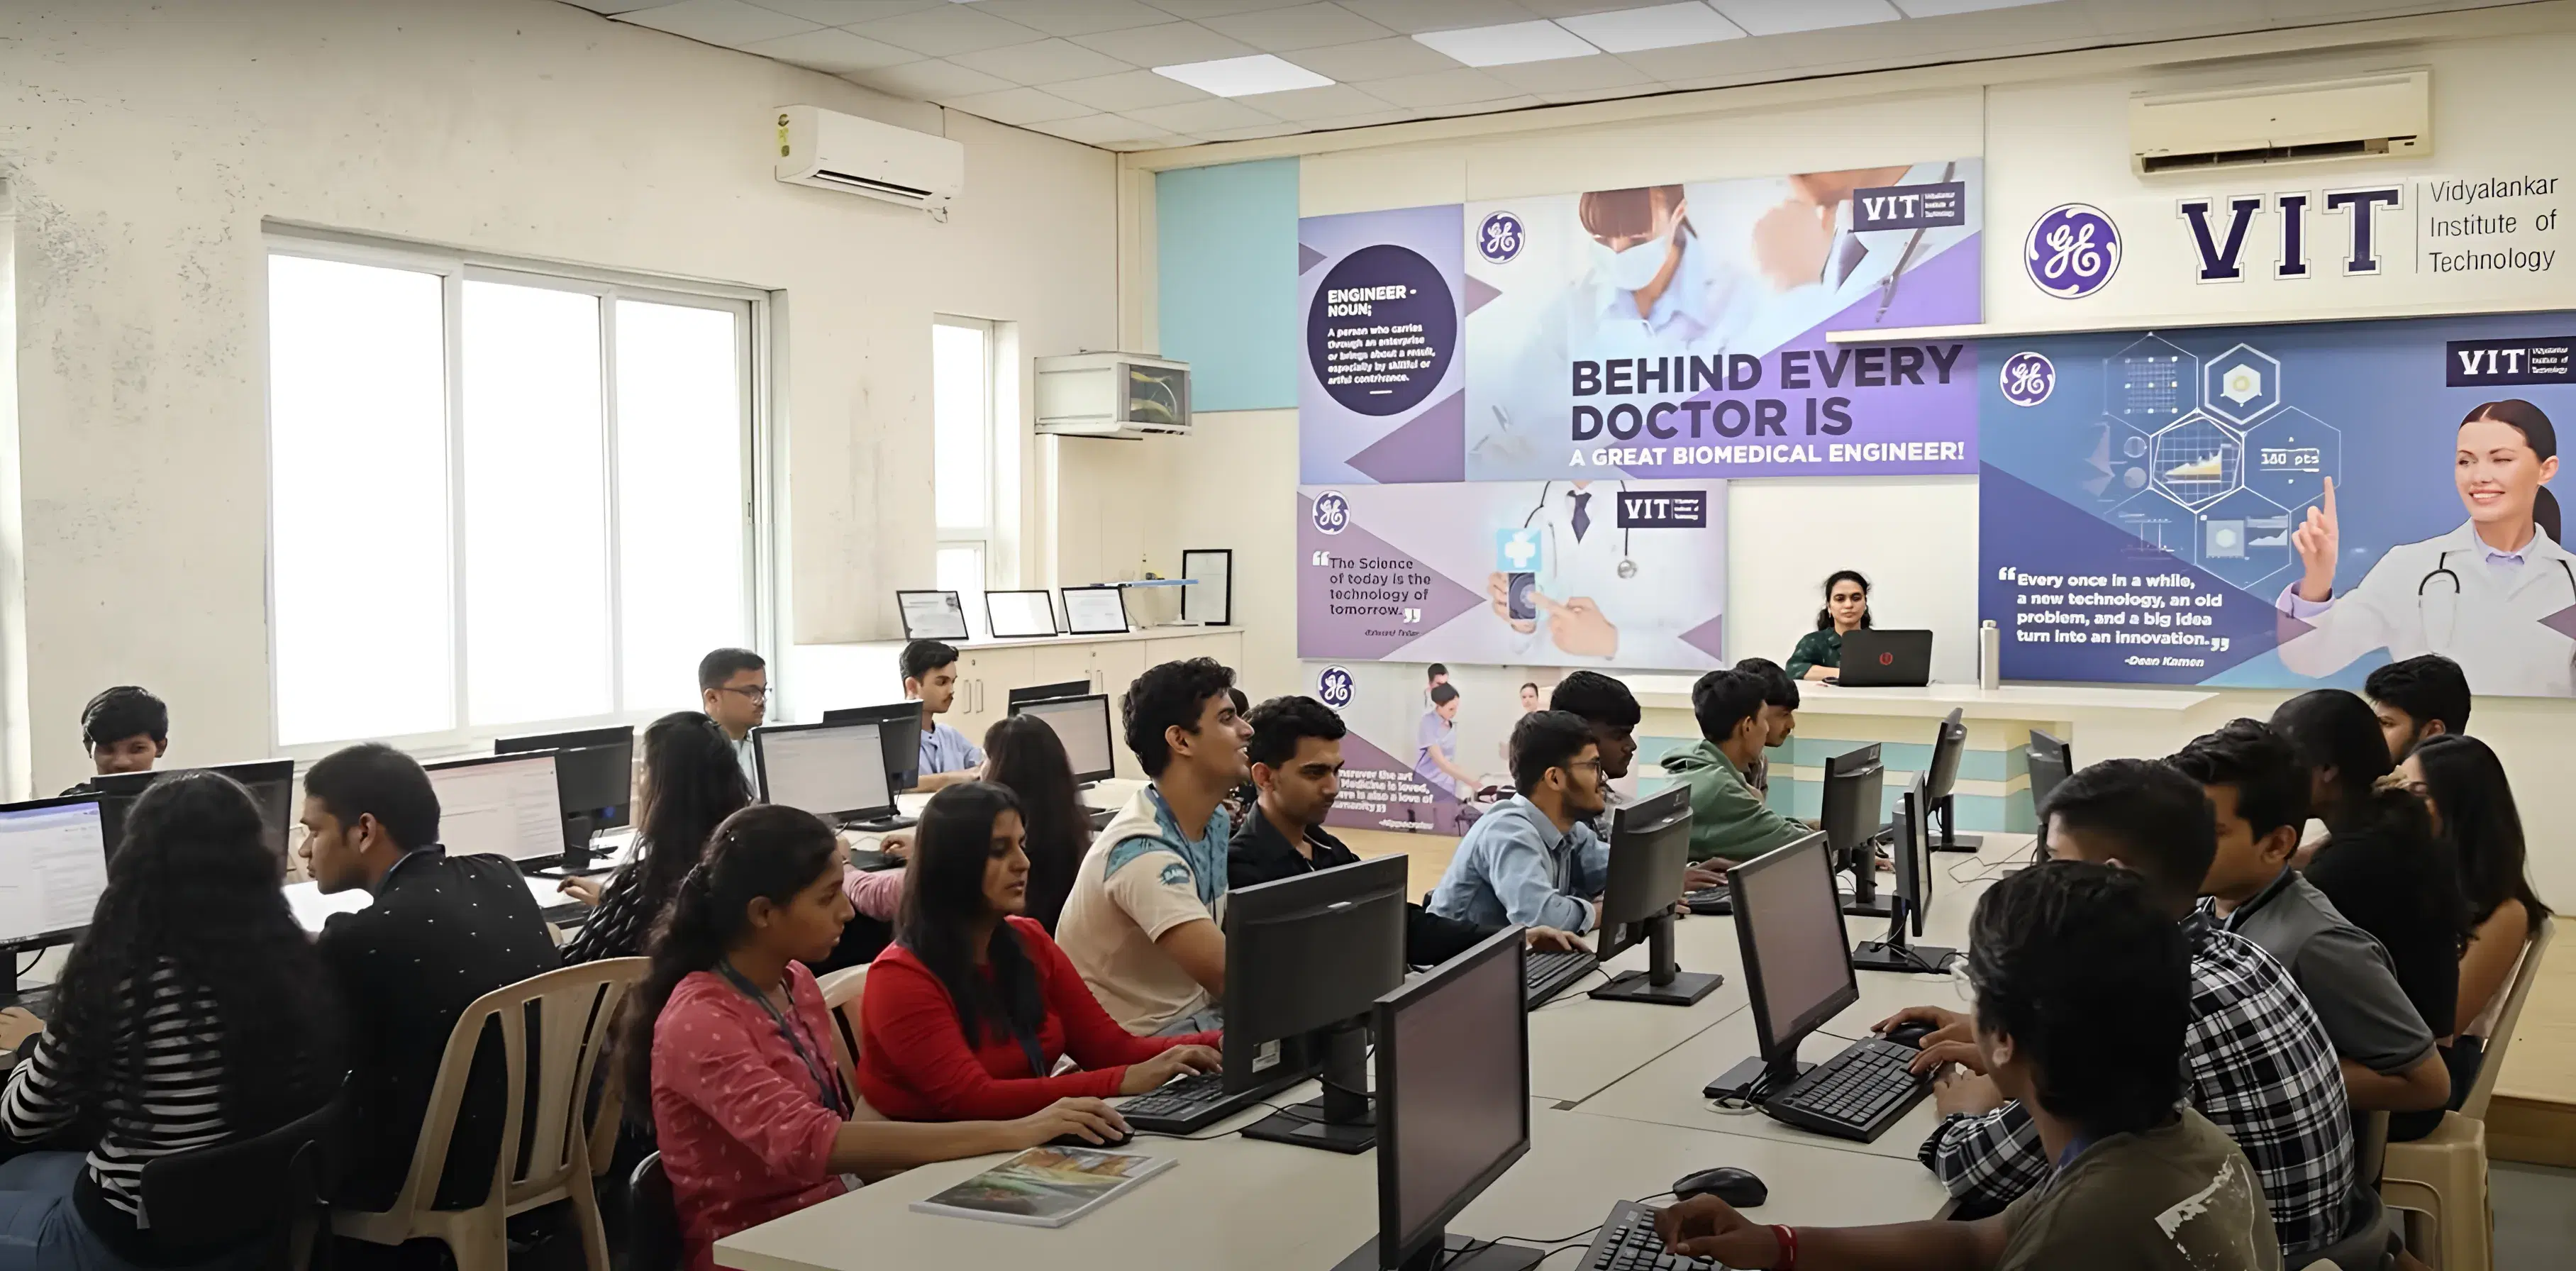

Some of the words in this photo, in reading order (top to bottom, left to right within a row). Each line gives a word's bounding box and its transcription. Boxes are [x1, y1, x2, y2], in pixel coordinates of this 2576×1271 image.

[2431, 175, 2558, 204] Vidyalankar
[1862, 194, 1919, 221] VIT
[2431, 214, 2516, 237] Institute
[2536, 209, 2557, 231] of
[2177, 185, 2403, 284] VIT
[2428, 248, 2555, 272] Technology
[1328, 284, 1406, 304] ENGINEER
[1328, 303, 1372, 317] NOUN;
[1328, 328, 1336, 338] A
[1370, 325, 1389, 335] who
[1572, 353, 1762, 396] BEHIND
[1781, 344, 1963, 389] EVERY
[2458, 349, 2526, 374] VIT
[1572, 396, 1787, 441] DOCTOR
[1806, 396, 1853, 436] IS
[1568, 450, 1586, 467] A
[1592, 447, 1667, 465] GREAT
[1673, 443, 1822, 465] BIOMEDICAL
[1829, 441, 1965, 462] ENGINEER!
[1624, 499, 1670, 519] VIT
[1359, 557, 1414, 570] Science
[1330, 573, 1344, 584] of
[1348, 573, 1388, 586] today
[1393, 573, 1404, 584] is
[1408, 573, 1431, 585] the
[2067, 575, 2107, 587] once
[2111, 573, 2127, 587] in
[2131, 575, 2141, 587] a
[2145, 574, 2195, 589] while,
[1330, 589, 1409, 602] technology
[1414, 589, 1428, 600] of
[2017, 594, 2027, 604] a
[2031, 594, 2063, 605] new
[2068, 593, 2165, 609] technology,
[2170, 596, 2190, 606] an
[2194, 594, 2223, 607] old
[2017, 610, 2089, 626] problem,
[2094, 611, 2126, 625] and
[2129, 614, 2140, 625] a
[2144, 612, 2171, 628] big
[2176, 612, 2212, 626] idea
[2016, 629, 2050, 643] turn
[2055, 630, 2087, 643] into
[2091, 631, 2111, 643] an
